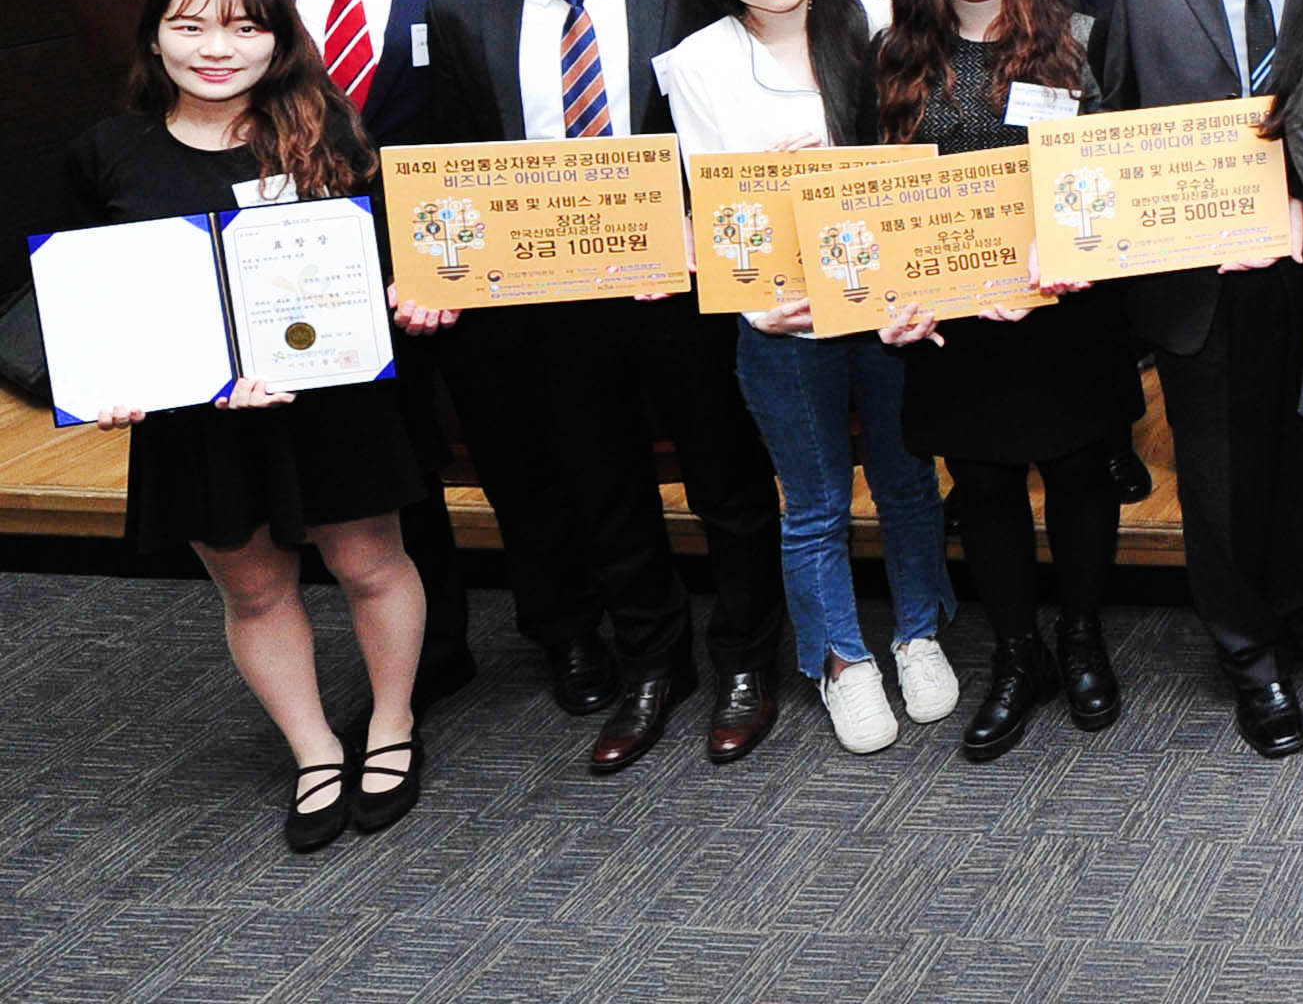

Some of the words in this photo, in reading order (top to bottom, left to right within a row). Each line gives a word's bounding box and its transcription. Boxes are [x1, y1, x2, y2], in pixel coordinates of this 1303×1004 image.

[395, 160, 436, 175] 제4회
[444, 155, 558, 174] 산업통상자원부
[563, 148, 672, 168] 공공데이터활용
[700, 165, 734, 180] 제4회
[443, 172, 507, 188] 비즈니스
[515, 169, 577, 185] 아이디어
[585, 166, 630, 182] 공모전
[739, 180, 791, 194] 비즈니스
[802, 185, 836, 202] 제4회
[840, 173, 933, 197] 산업통상자원부
[938, 160, 1030, 183] 공공데이터활용
[490, 199, 519, 213] 제품
[526, 198, 539, 211] 및
[547, 195, 591, 210] 서비스
[598, 193, 627, 206] 개발
[634, 190, 663, 204] 부문
[840, 194, 894, 212] 비즈니스
[899, 186, 951, 204] 아이디어
[957, 180, 996, 197] 공모전
[1140, 207, 1177, 227] 상금
[1185, 197, 1256, 222] 500만원
[513, 240, 556, 260] 상금
[568, 234, 648, 256] 100만원
[904, 259, 941, 279] 상금
[948, 247, 1017, 272] 500만원
